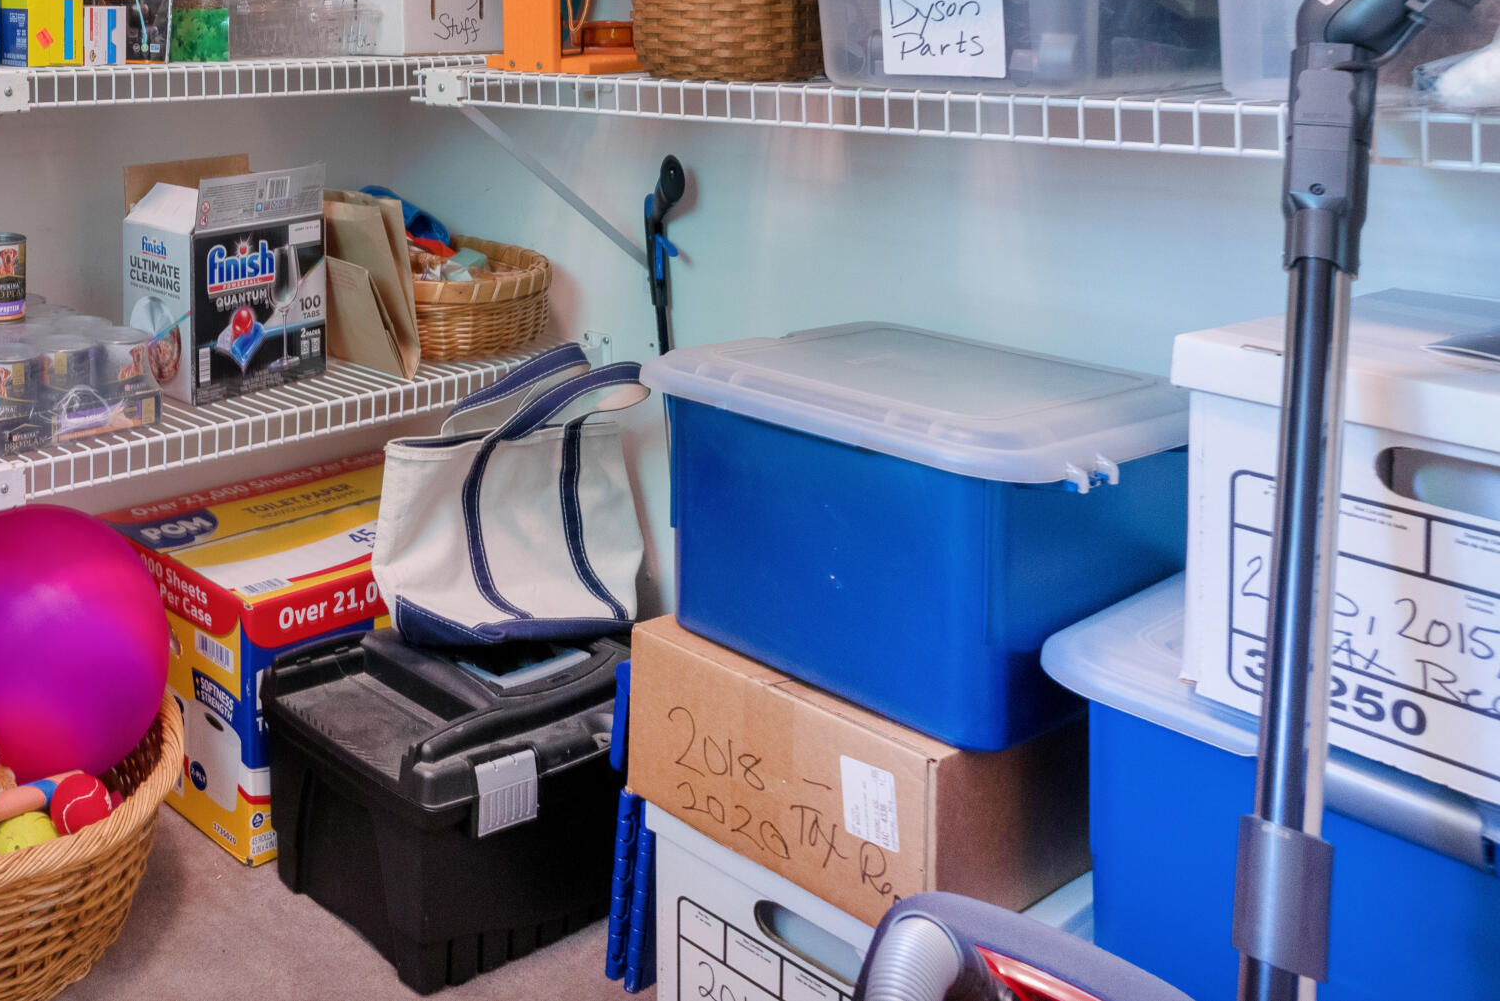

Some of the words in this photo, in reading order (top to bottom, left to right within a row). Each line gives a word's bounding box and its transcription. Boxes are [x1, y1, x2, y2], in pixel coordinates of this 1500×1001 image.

[434, 13, 481, 45] Stuff
[897, 31, 985, 60] Parts
[141, 235, 167, 257] finish
[207, 239, 276, 286] finish
[130, 255, 181, 280] ULTIMATE
[130, 268, 181, 293] CLEANING
[0, 304, 20, 313] PROTEIN
[216, 287, 268, 307] QUANTUM
[300, 295, 321, 312] 100
[302, 309, 321, 319] TABS
[130, 495, 178, 518] Over
[183, 480, 250, 507] 21,000
[251, 467, 308, 492] Sheets
[309, 461, 338, 482] Per
[242, 495, 297, 515] TOILET
[299, 482, 354, 501] PAPER
[140, 516, 214, 543] POM
[165, 568, 208, 605] Sheets
[159, 583, 180, 606] Per
[182, 595, 213, 628] Case
[278, 600, 328, 631] Over
[332, 581, 384, 614] 21,0
[1395, 597, 1500, 661] 2015
[200, 676, 235, 713] SOFTNESS
[200, 690, 234, 723] STRENGTH
[667, 706, 766, 792] 2018
[676, 780, 792, 860] 2020
